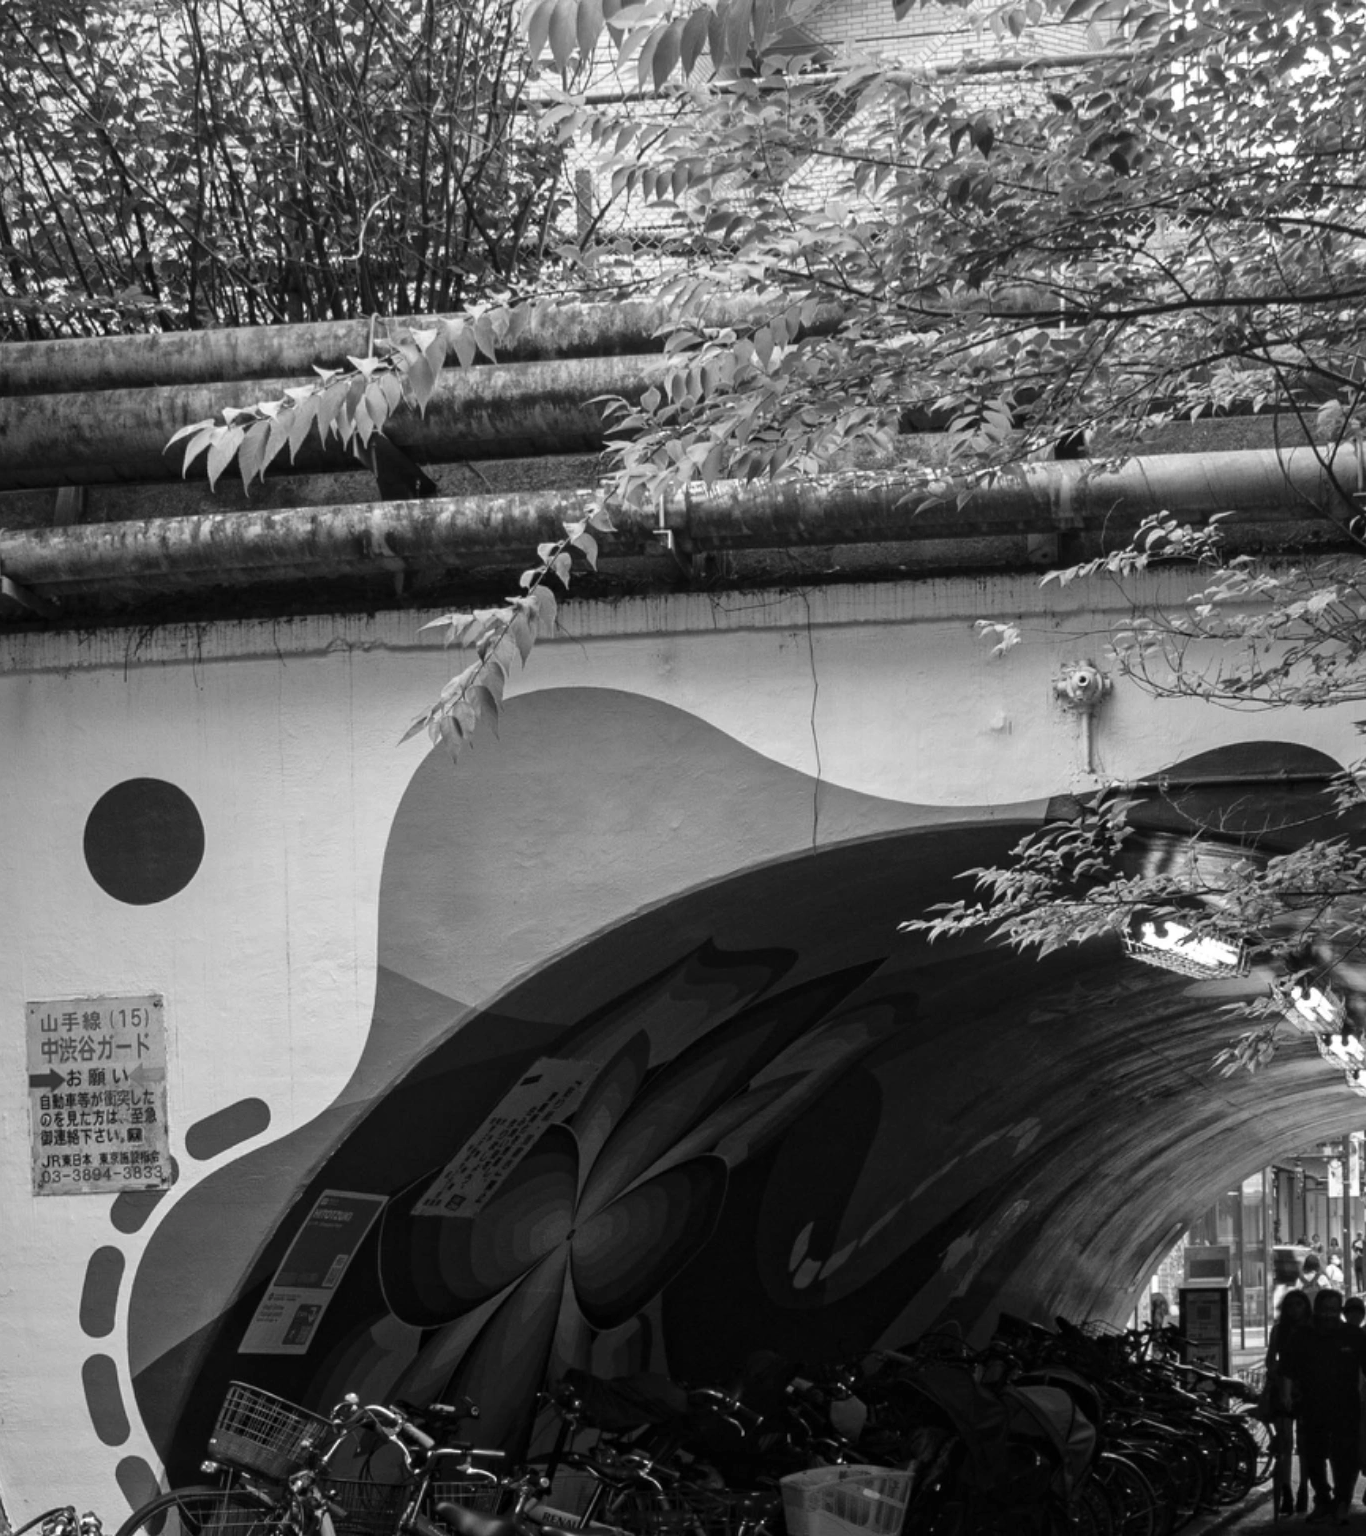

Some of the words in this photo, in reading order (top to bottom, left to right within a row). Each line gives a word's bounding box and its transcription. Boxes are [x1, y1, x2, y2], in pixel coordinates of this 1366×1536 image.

[40, 1011, 102, 1033] 山手線
[110, 1008, 150, 1029] (15)
[40, 1033, 150, 1063] 中渋谷ガード
[66, 1068, 129, 1087] お願い
[39, 1089, 155, 1110] 自動車等が衝突した
[39, 1107, 157, 1127] のを見た方は、至急
[41, 1153, 93, 1168] JR東日本
[41, 1166, 163, 1183] 03-3894-3833
